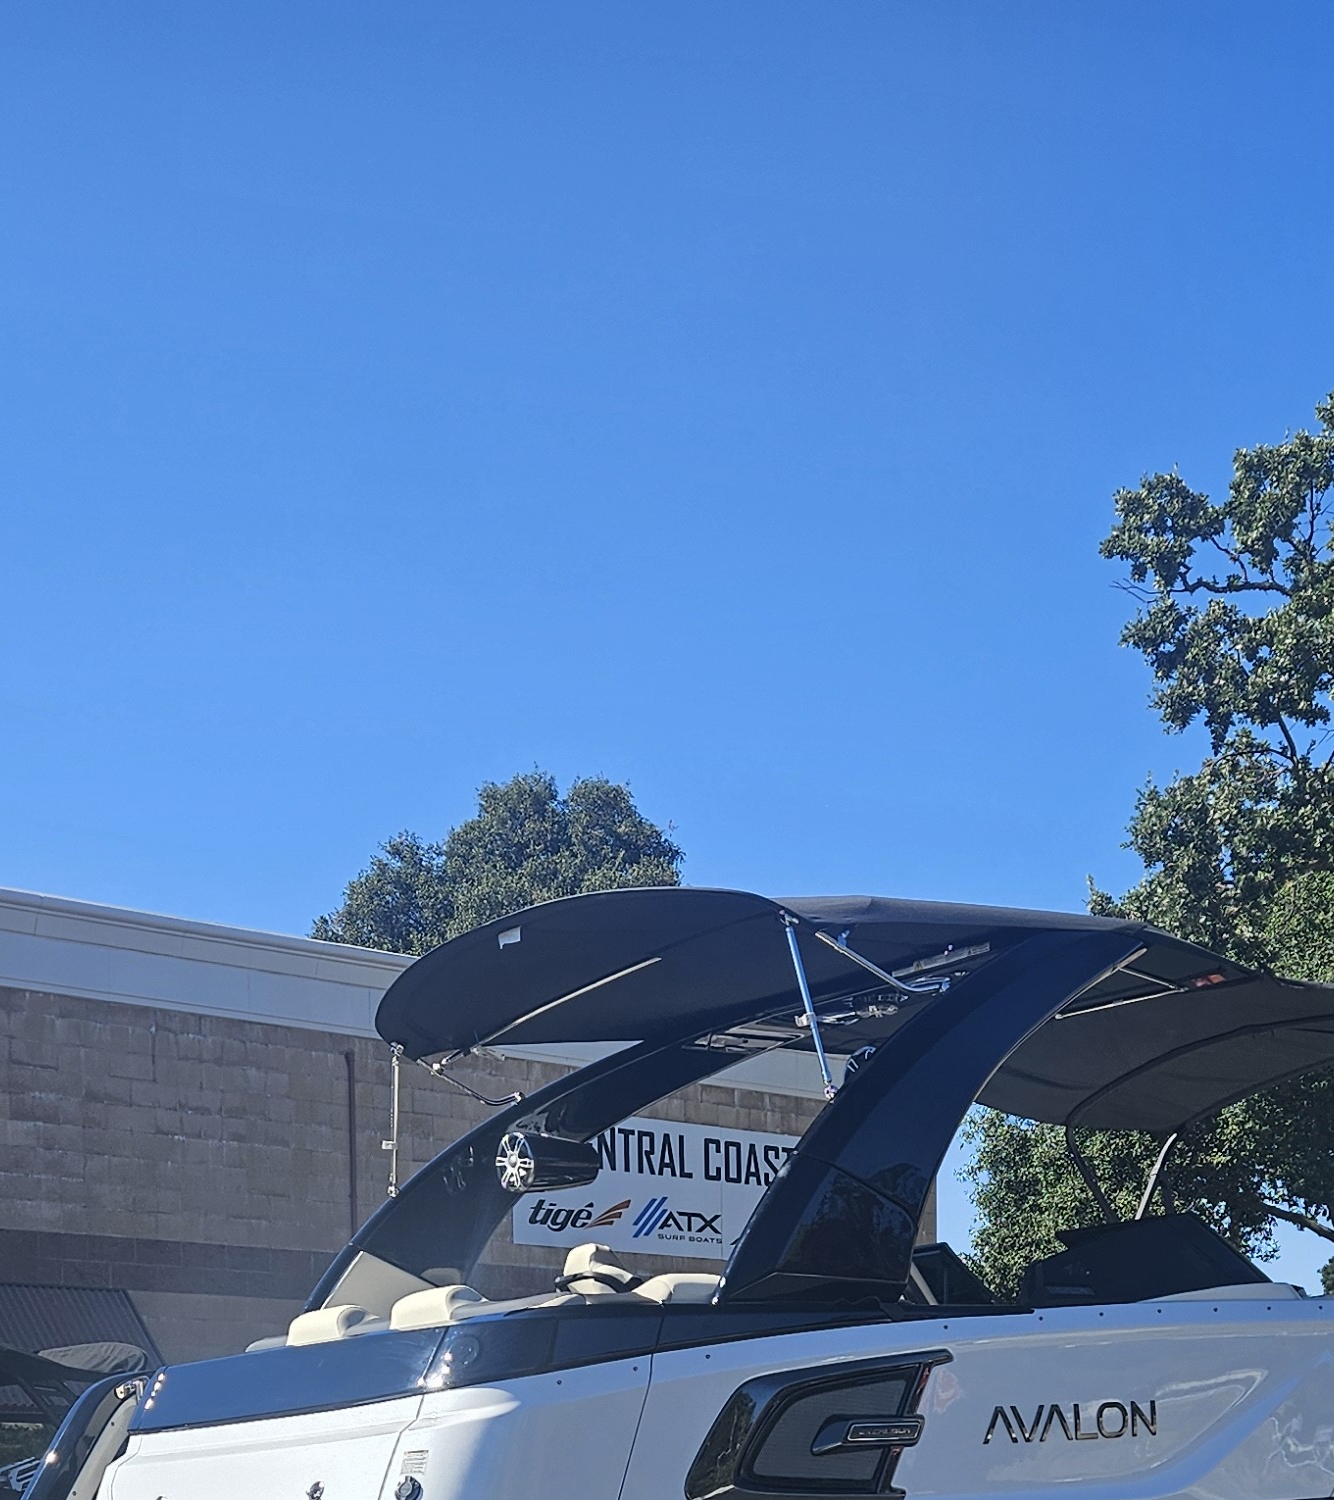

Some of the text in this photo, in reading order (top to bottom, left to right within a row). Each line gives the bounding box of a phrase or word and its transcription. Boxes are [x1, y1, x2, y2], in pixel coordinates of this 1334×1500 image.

[595, 1127, 796, 1187] NTRAL COAS
[657, 1233, 686, 1242] SURF
[688, 1236, 723, 1244] BOATS
[658, 1211, 722, 1235] ATX
[982, 1399, 1157, 1445] AVALON
